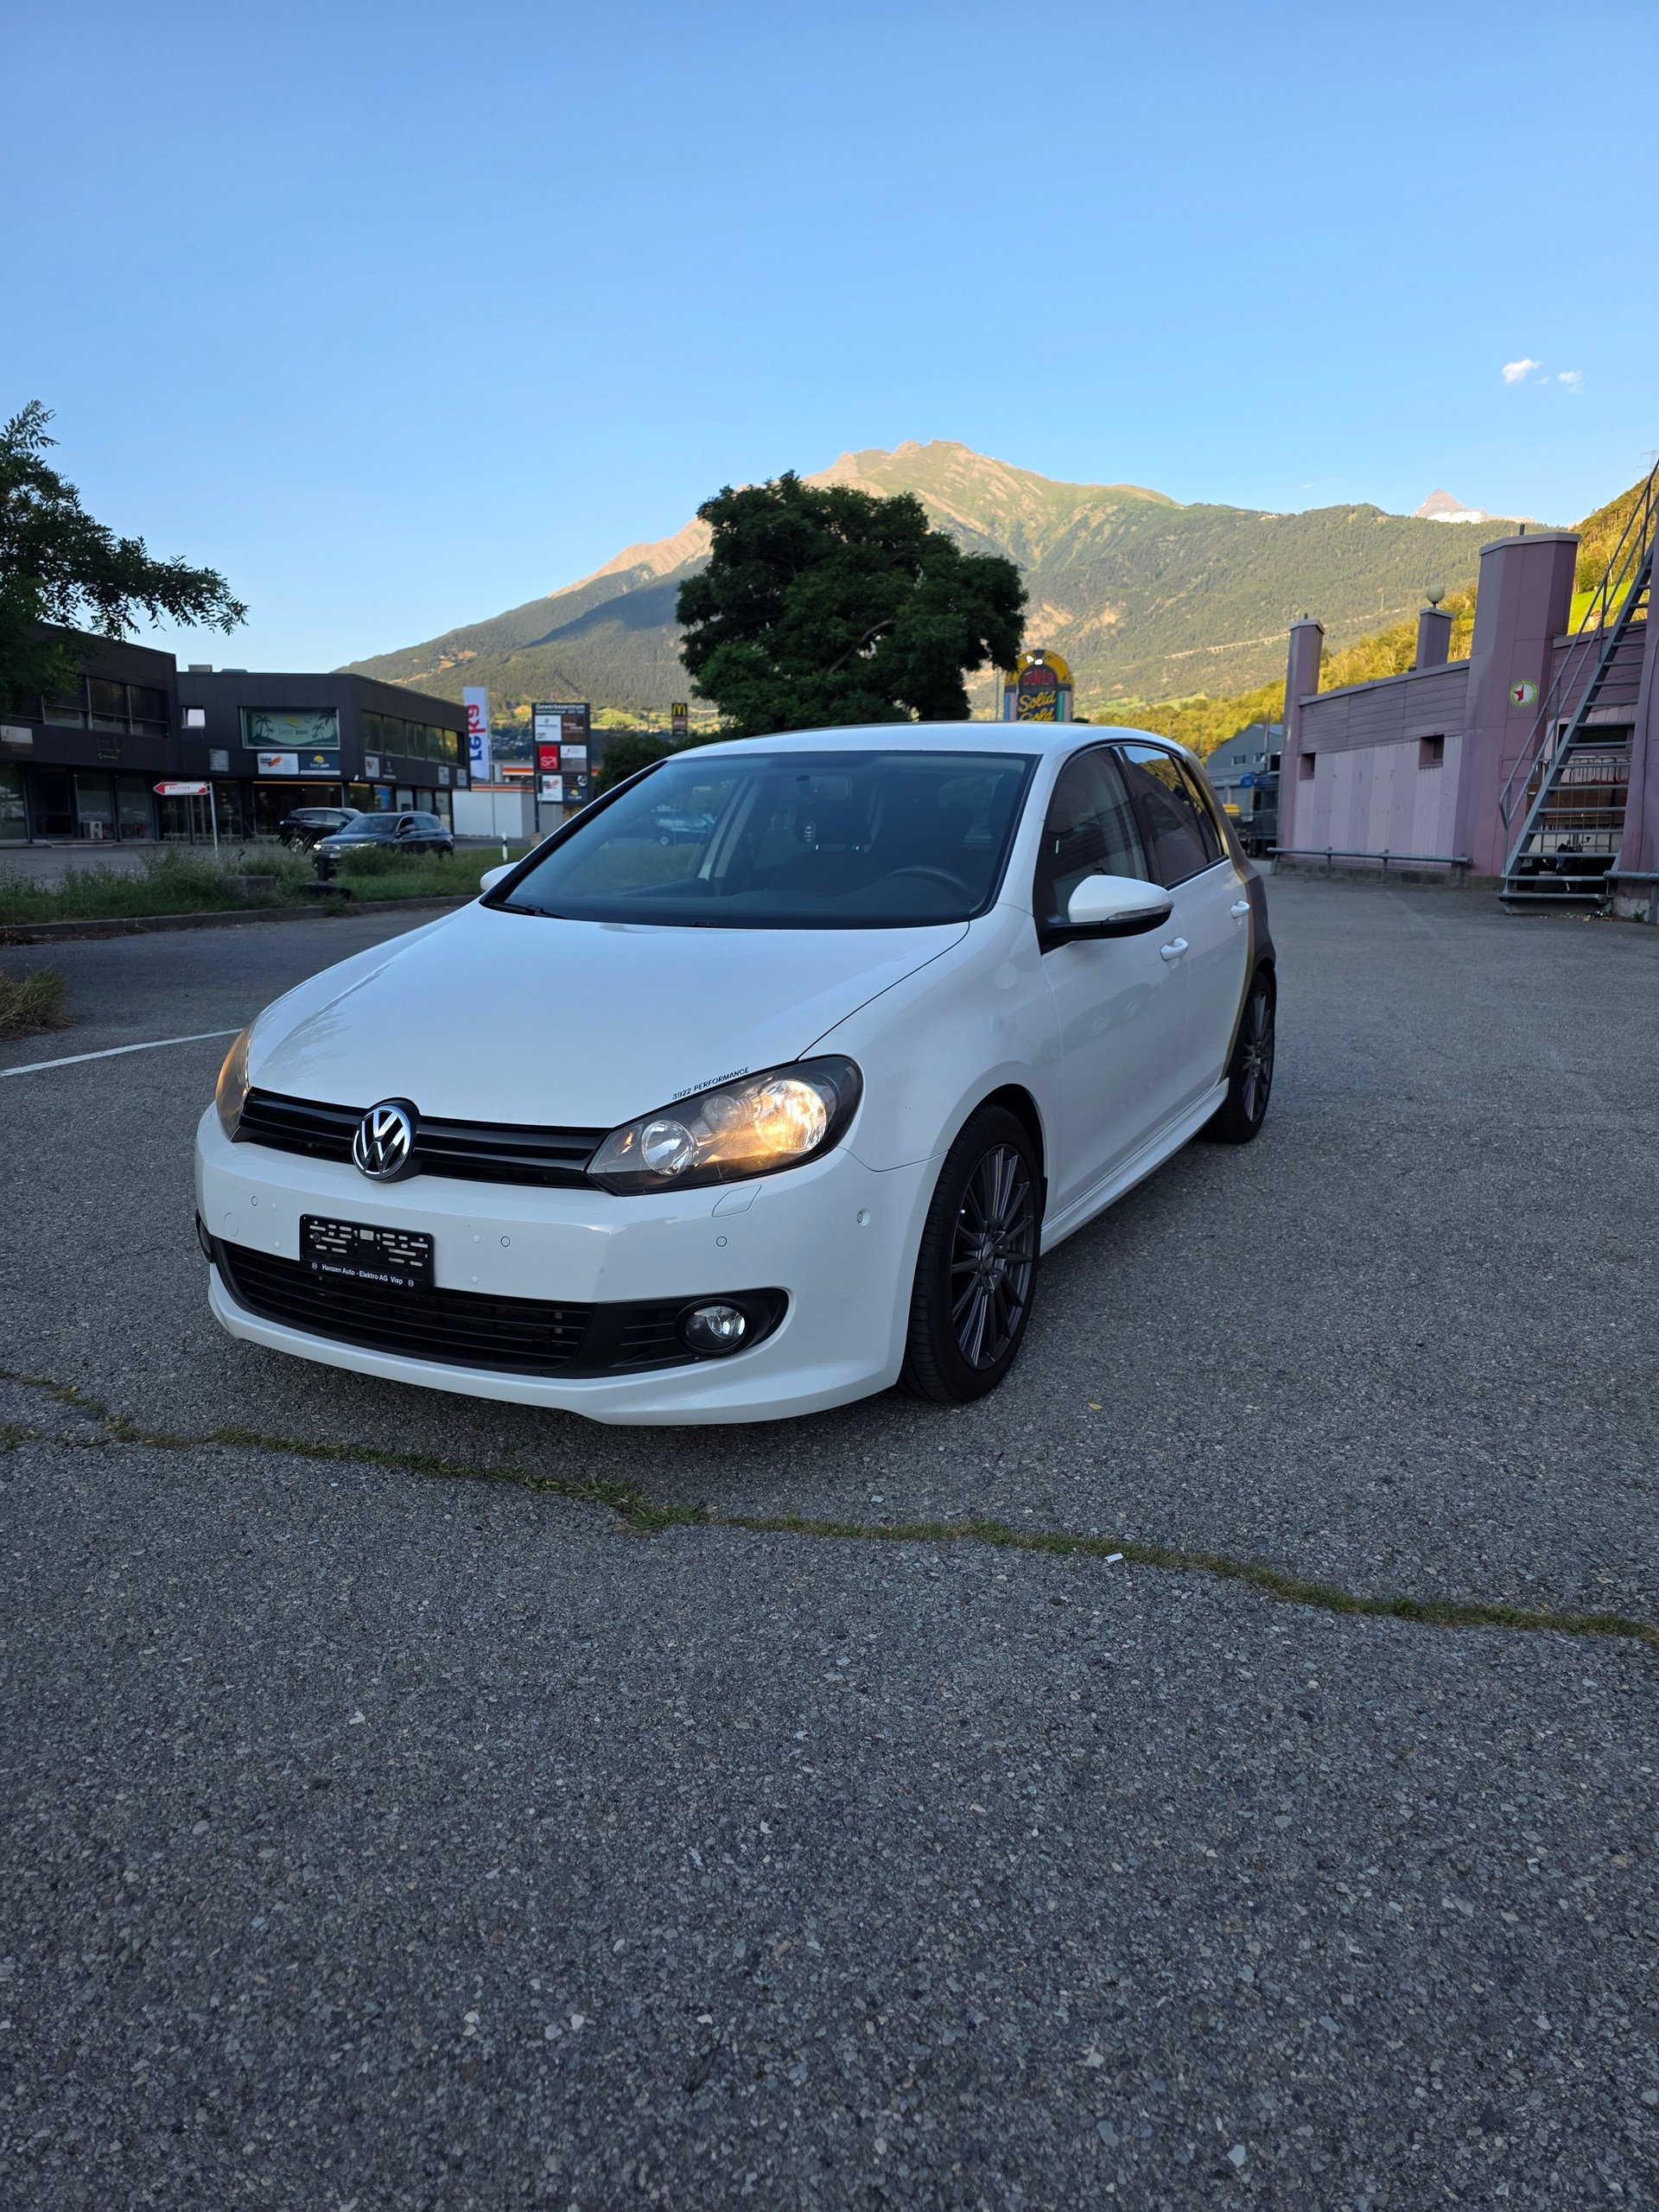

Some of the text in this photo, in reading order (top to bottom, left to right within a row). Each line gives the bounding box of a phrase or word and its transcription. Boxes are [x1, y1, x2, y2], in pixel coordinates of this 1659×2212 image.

[1023, 669, 1054, 685] DINER
[1018, 690, 1056, 712] Solid
[540, 755, 557, 767] SPI
[672, 1066, 749, 1100] 3922 PERFORMANCE
[321, 1262, 342, 1274] Henzen
[342, 1268, 355, 1276] Auto
[359, 1270, 378, 1281] Elektro
[378, 1274, 389, 1282] AG
[390, 1275, 404, 1286] Visp
